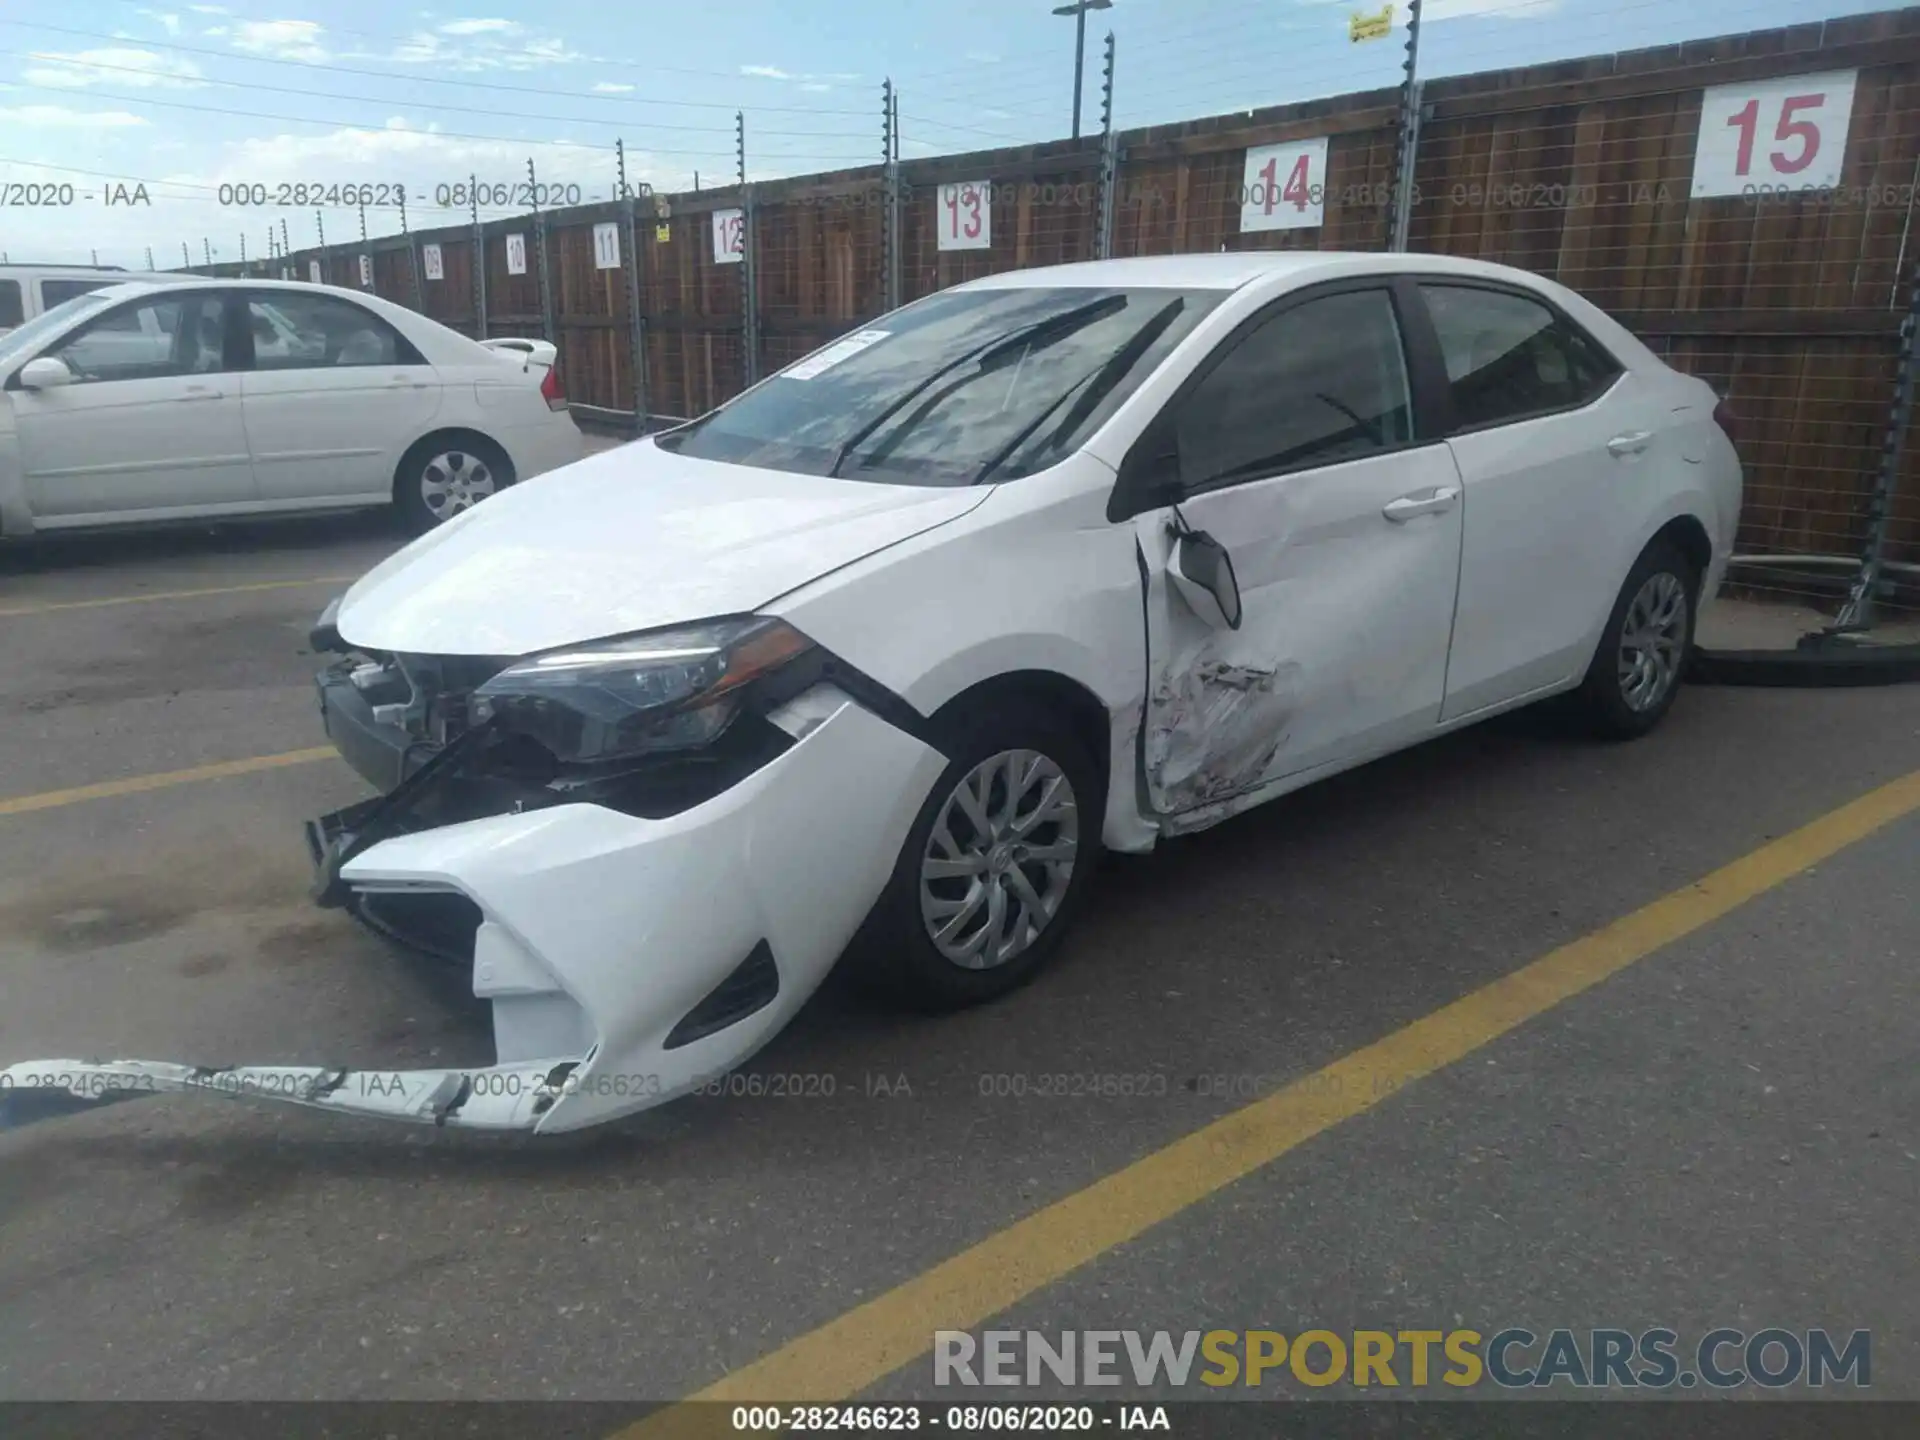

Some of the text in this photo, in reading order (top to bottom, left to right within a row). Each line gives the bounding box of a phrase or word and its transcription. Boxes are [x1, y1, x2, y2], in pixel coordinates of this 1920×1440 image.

[1727, 93, 1826, 175] 15
[1259, 154, 1311, 217] 14
[719, 217, 742, 255] 12
[946, 187, 983, 240] 13
[599, 233, 615, 262] 11
